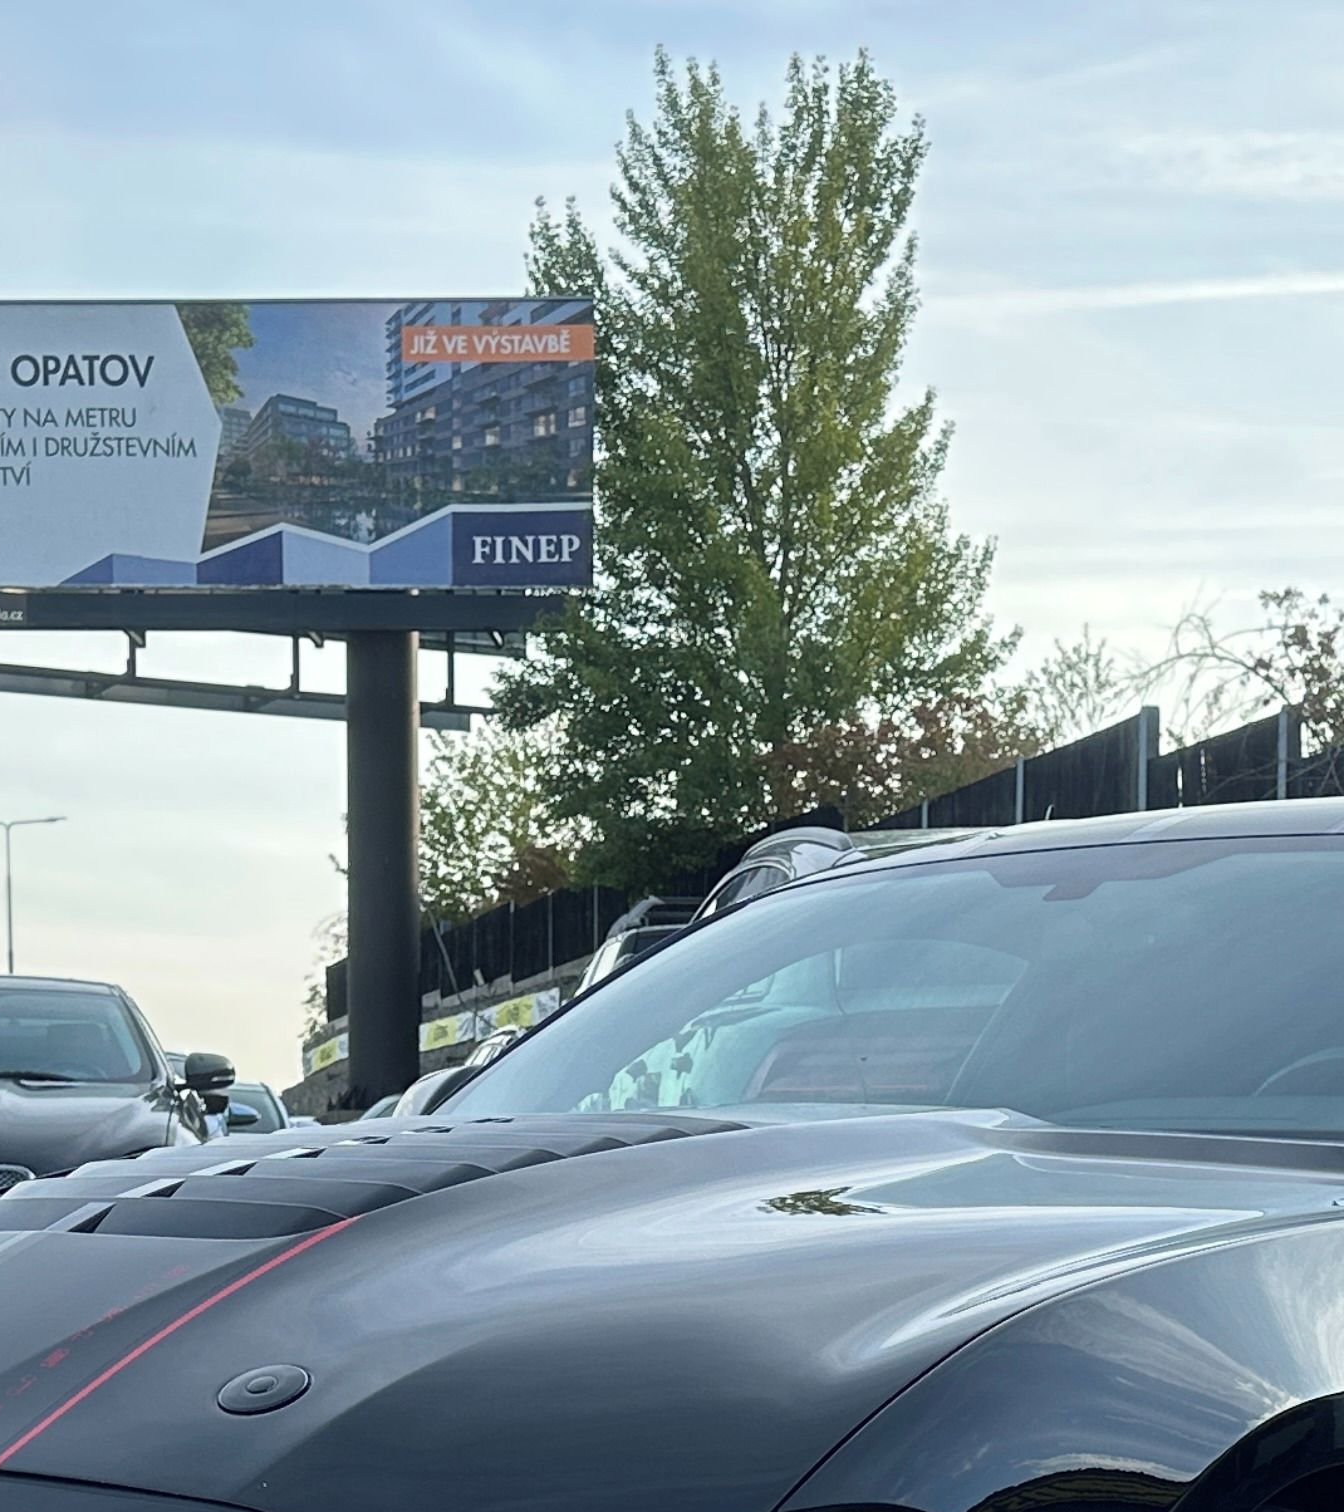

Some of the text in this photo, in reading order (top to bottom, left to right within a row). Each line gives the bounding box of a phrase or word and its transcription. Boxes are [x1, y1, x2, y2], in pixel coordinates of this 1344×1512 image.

[410, 329, 571, 354] JIŽ VE VÝSTAVBĚ
[10, 354, 155, 388] OPATOV
[23, 408, 58, 428] NA
[64, 407, 137, 428] METRU
[44, 432, 198, 458] DRUŽSTEVNÍM
[471, 534, 581, 564] FINEP
